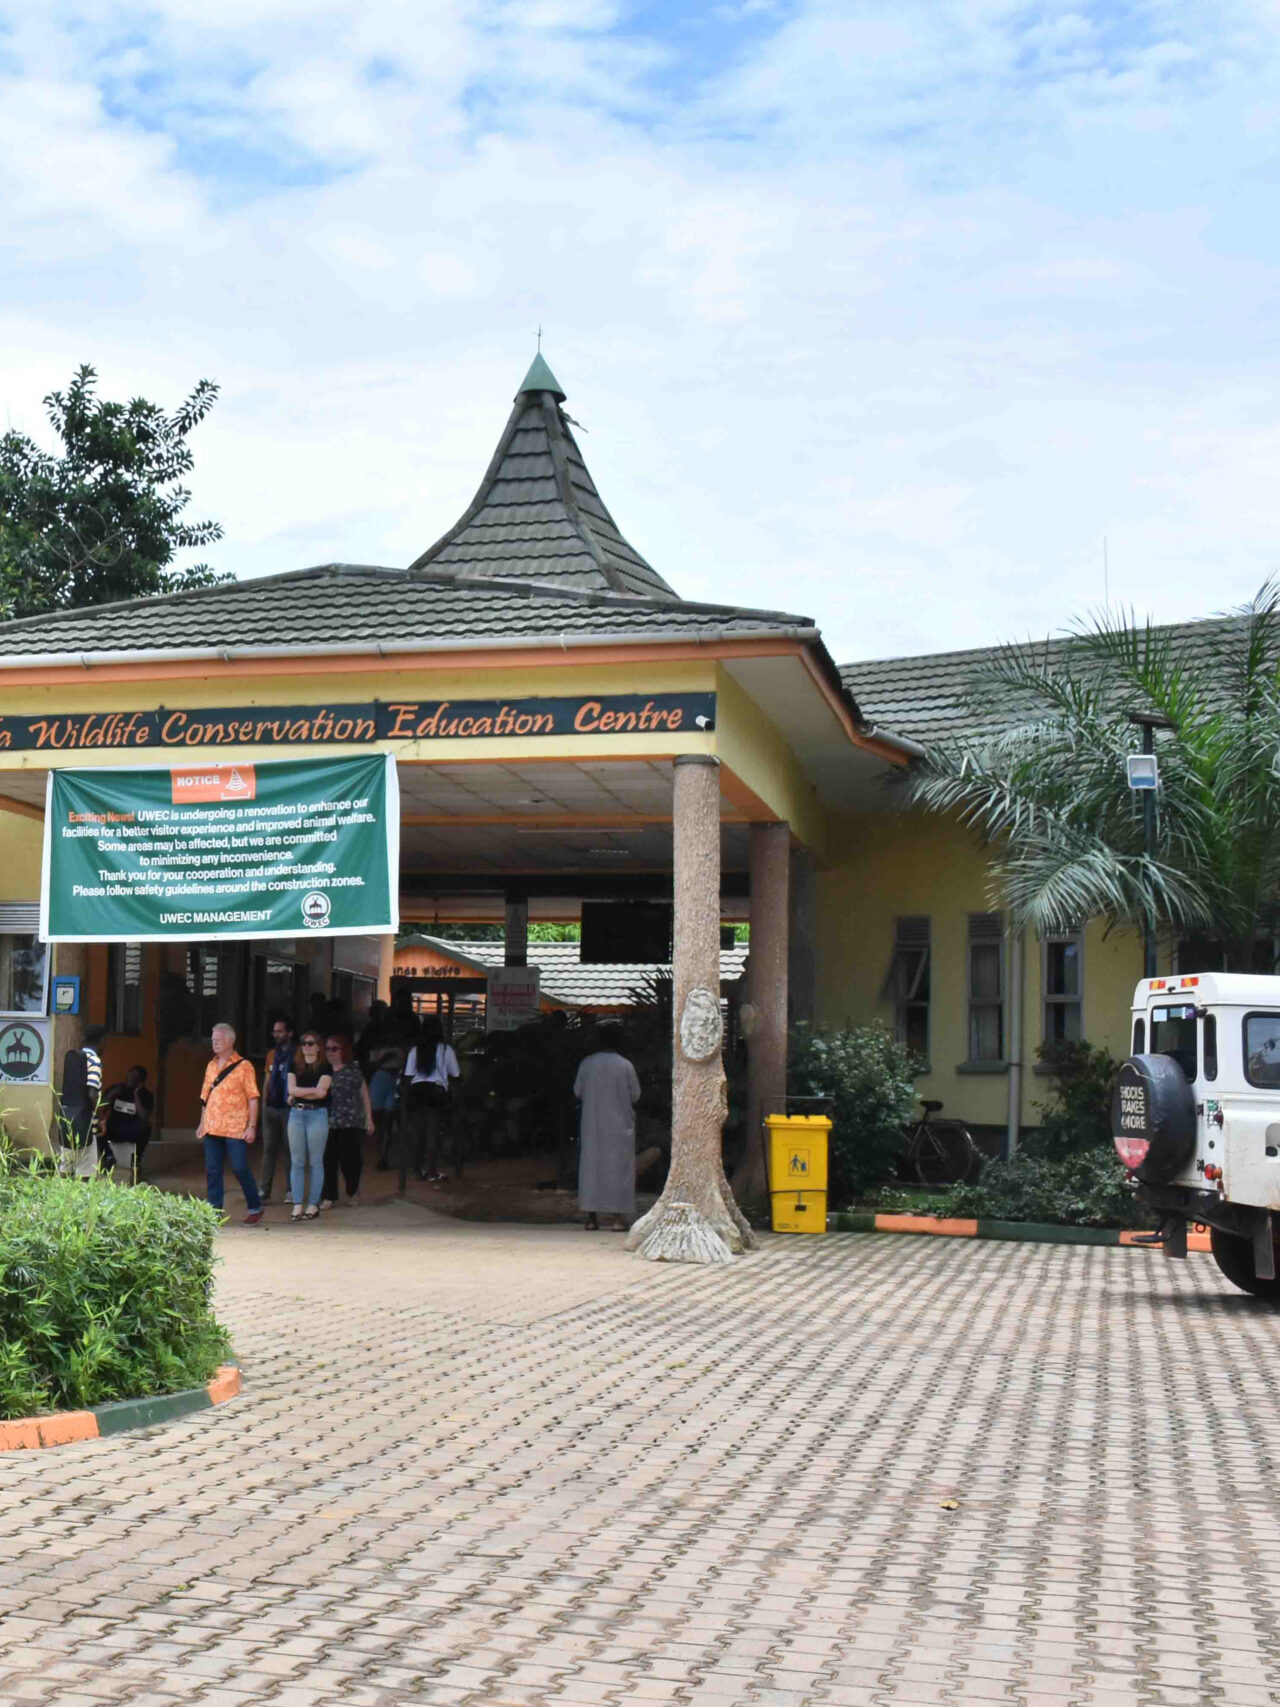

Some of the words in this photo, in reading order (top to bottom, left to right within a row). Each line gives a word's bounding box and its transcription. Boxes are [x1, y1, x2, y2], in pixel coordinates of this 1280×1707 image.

[28, 712, 150, 749] Wildlife
[160, 706, 377, 746] Conservation
[386, 702, 554, 738] Education
[573, 700, 683, 732] Centre
[176, 775, 221, 787] NOTICE
[68, 810, 106, 825] Exciting
[107, 811, 135, 823] News!
[137, 809, 170, 822] UWEC
[170, 809, 180, 821] is
[180, 807, 236, 821] undergoing
[236, 808, 244, 818] a
[244, 803, 296, 817] renovation
[297, 802, 308, 814] to
[308, 799, 352, 812] enhance
[352, 798, 369, 809] our
[62, 824, 100, 838] facilities
[100, 825, 115, 837] for
[115, 827, 122, 837] a
[122, 824, 150, 837] better
[150, 823, 180, 836] visitor
[180, 822, 235, 836] experience
[235, 820, 255, 832] and
[255, 817, 302, 832] improved
[303, 814, 336, 828] animal
[337, 812, 376, 825] welfare.
[97, 840, 127, 851] Some
[127, 841, 154, 852] areas
[154, 840, 174, 852] may
[174, 838, 188, 850] be
[188, 836, 231, 850] affected,
[231, 835, 249, 848] but
[248, 836, 264, 847] we
[264, 835, 282, 846] are
[282, 829, 338, 845] committed
[139, 854, 151, 866] to
[150, 853, 201, 866] minimizing
[201, 853, 220, 866] any
[220, 849, 294, 864] inconvenience.
[98, 869, 128, 881] Thank
[127, 871, 146, 883] you
[146, 868, 162, 880] for
[162, 870, 185, 882] your
[185, 866, 244, 881] cooperation
[244, 865, 264, 878] and
[264, 861, 337, 876] understanding.
[72, 885, 106, 896] Please
[106, 884, 134, 896] follow
[134, 884, 165, 897] safety
[165, 882, 215, 897] guidelines
[215, 880, 250, 893] around
[250, 880, 267, 892] the
[267, 876, 331, 891] construction
[331, 876, 366, 888] zones.
[159, 912, 193, 924] UWEC
[193, 910, 273, 923] MANAGEMENT
[304, 917, 330, 927] UWEC
